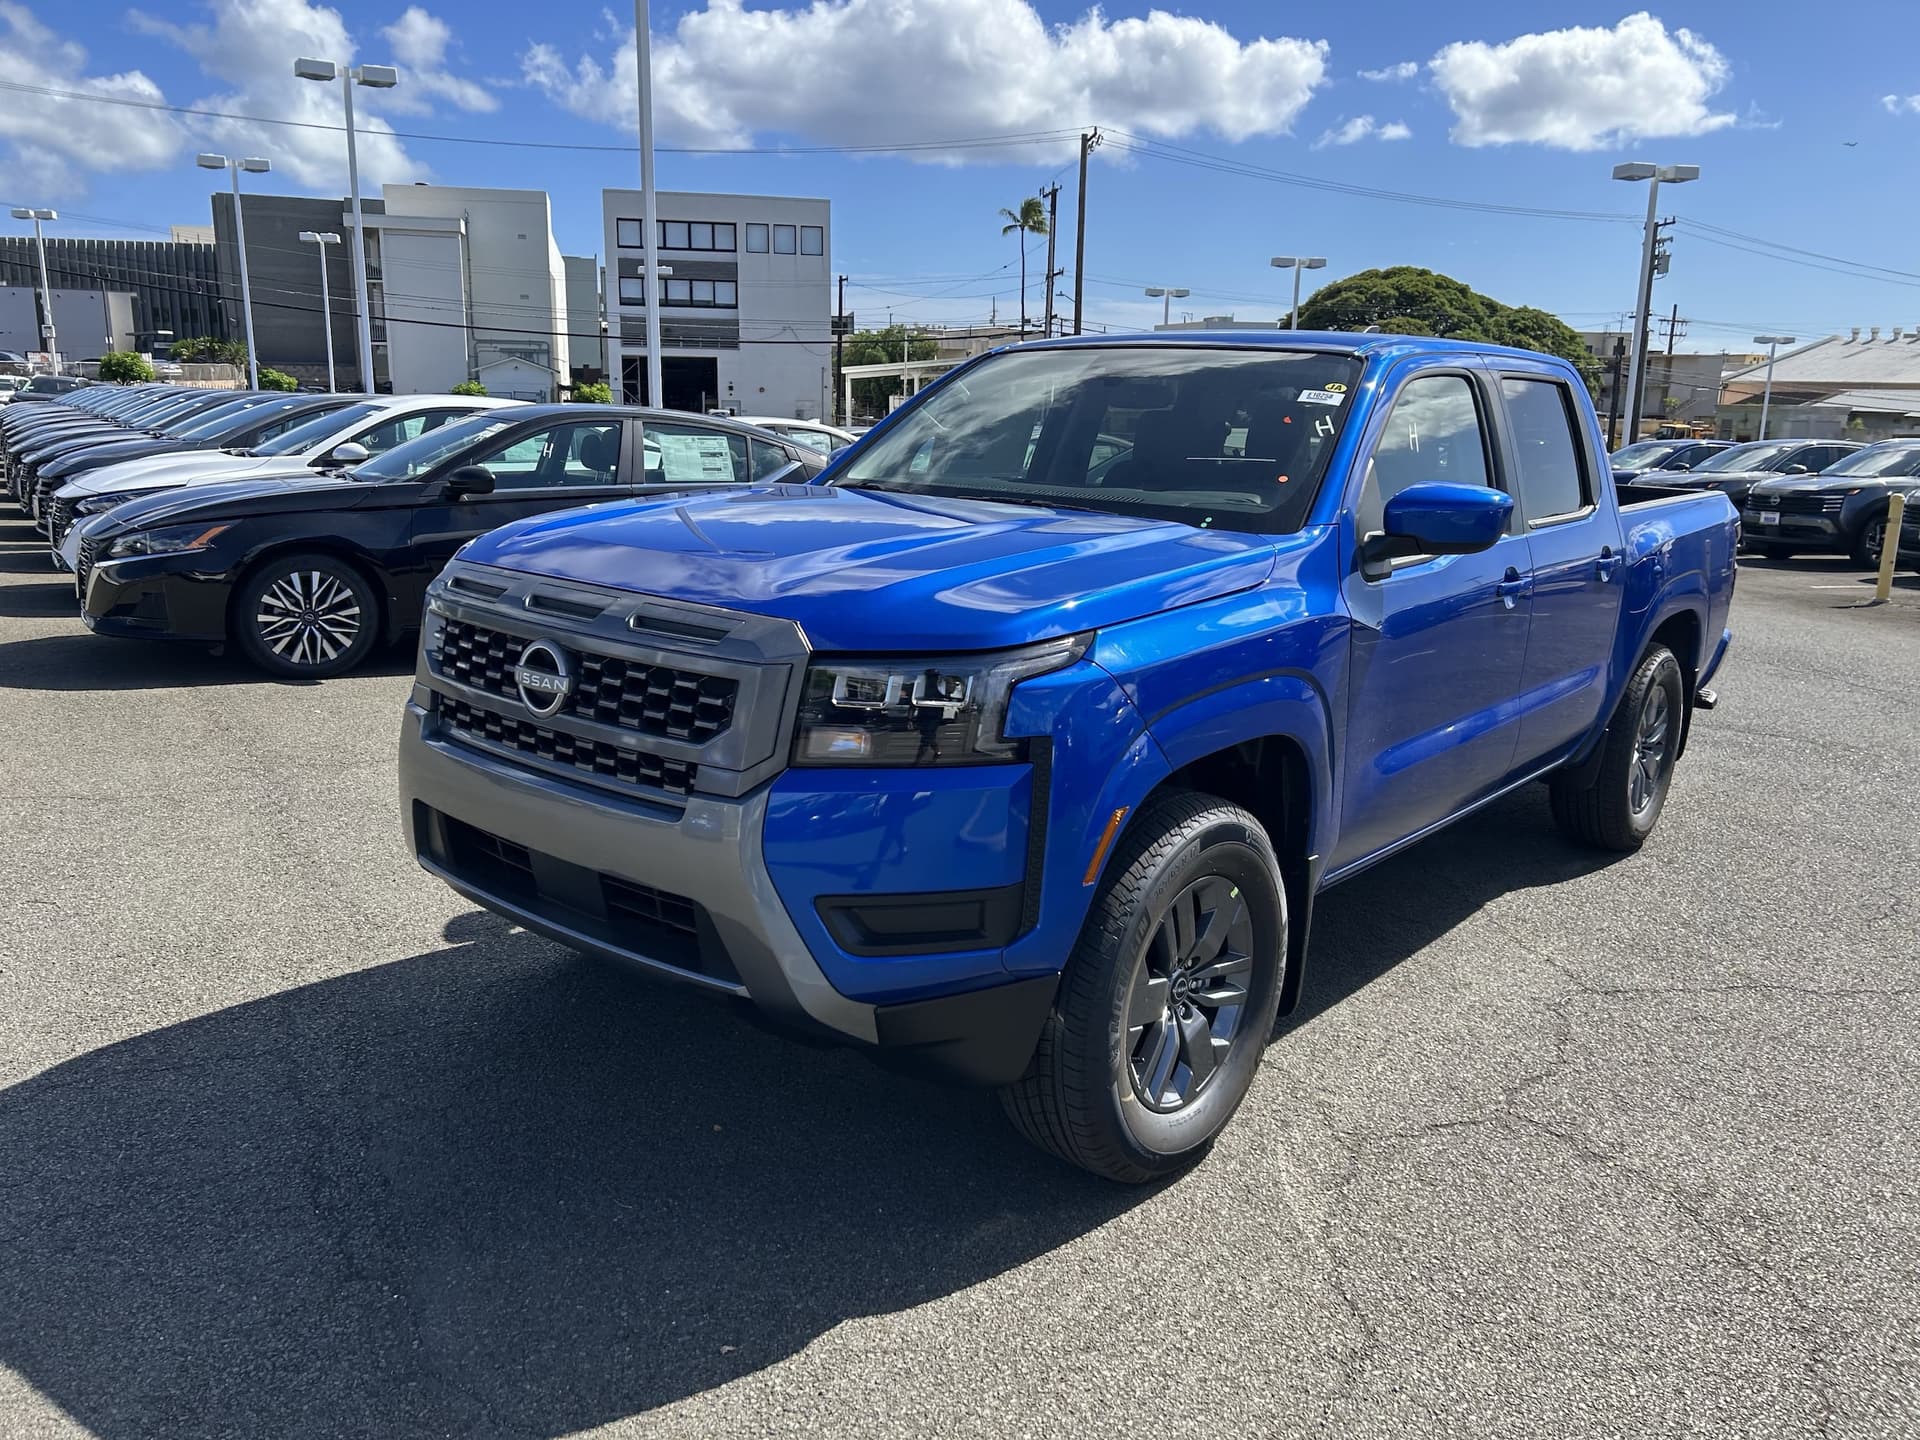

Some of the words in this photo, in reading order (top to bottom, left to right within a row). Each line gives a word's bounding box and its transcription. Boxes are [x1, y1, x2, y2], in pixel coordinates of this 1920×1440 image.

[1327, 383, 1342, 391] JA
[1315, 415, 1335, 437] H
[1408, 422, 1420, 453] H
[543, 442, 554, 459] H
